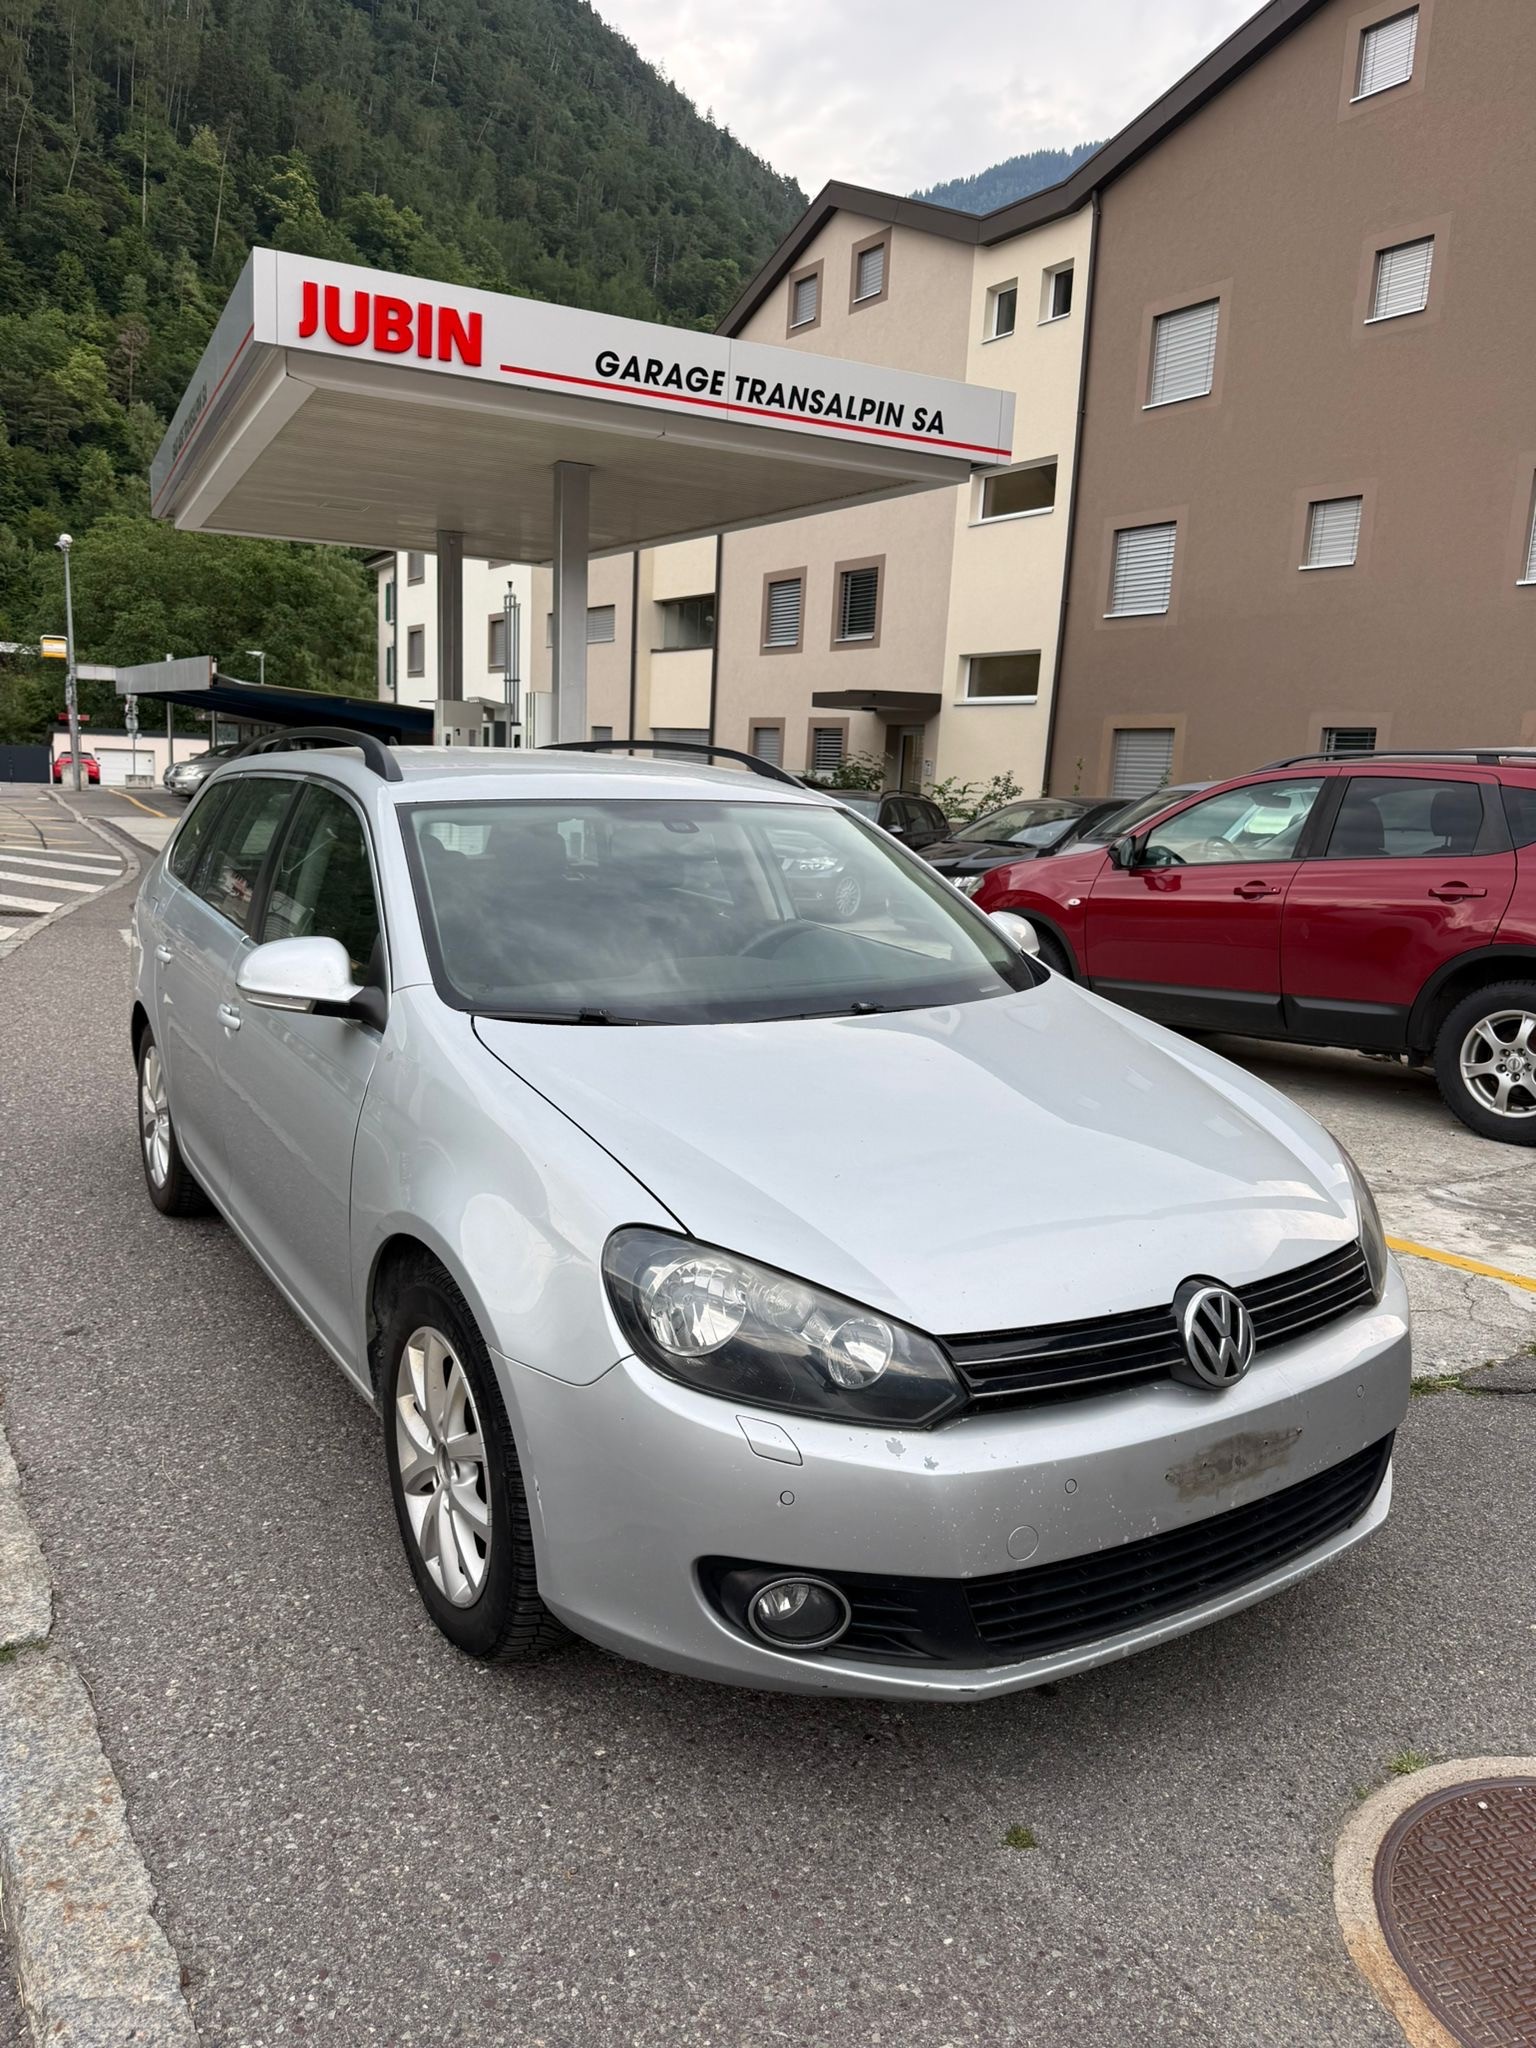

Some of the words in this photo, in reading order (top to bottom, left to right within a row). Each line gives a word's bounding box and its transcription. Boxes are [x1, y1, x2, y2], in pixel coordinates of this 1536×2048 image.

[299, 281, 483, 367] JUBIN
[595, 350, 725, 396] GARAGE
[735, 375, 905, 428] TRANSALPIN
[911, 407, 945, 435] SA
